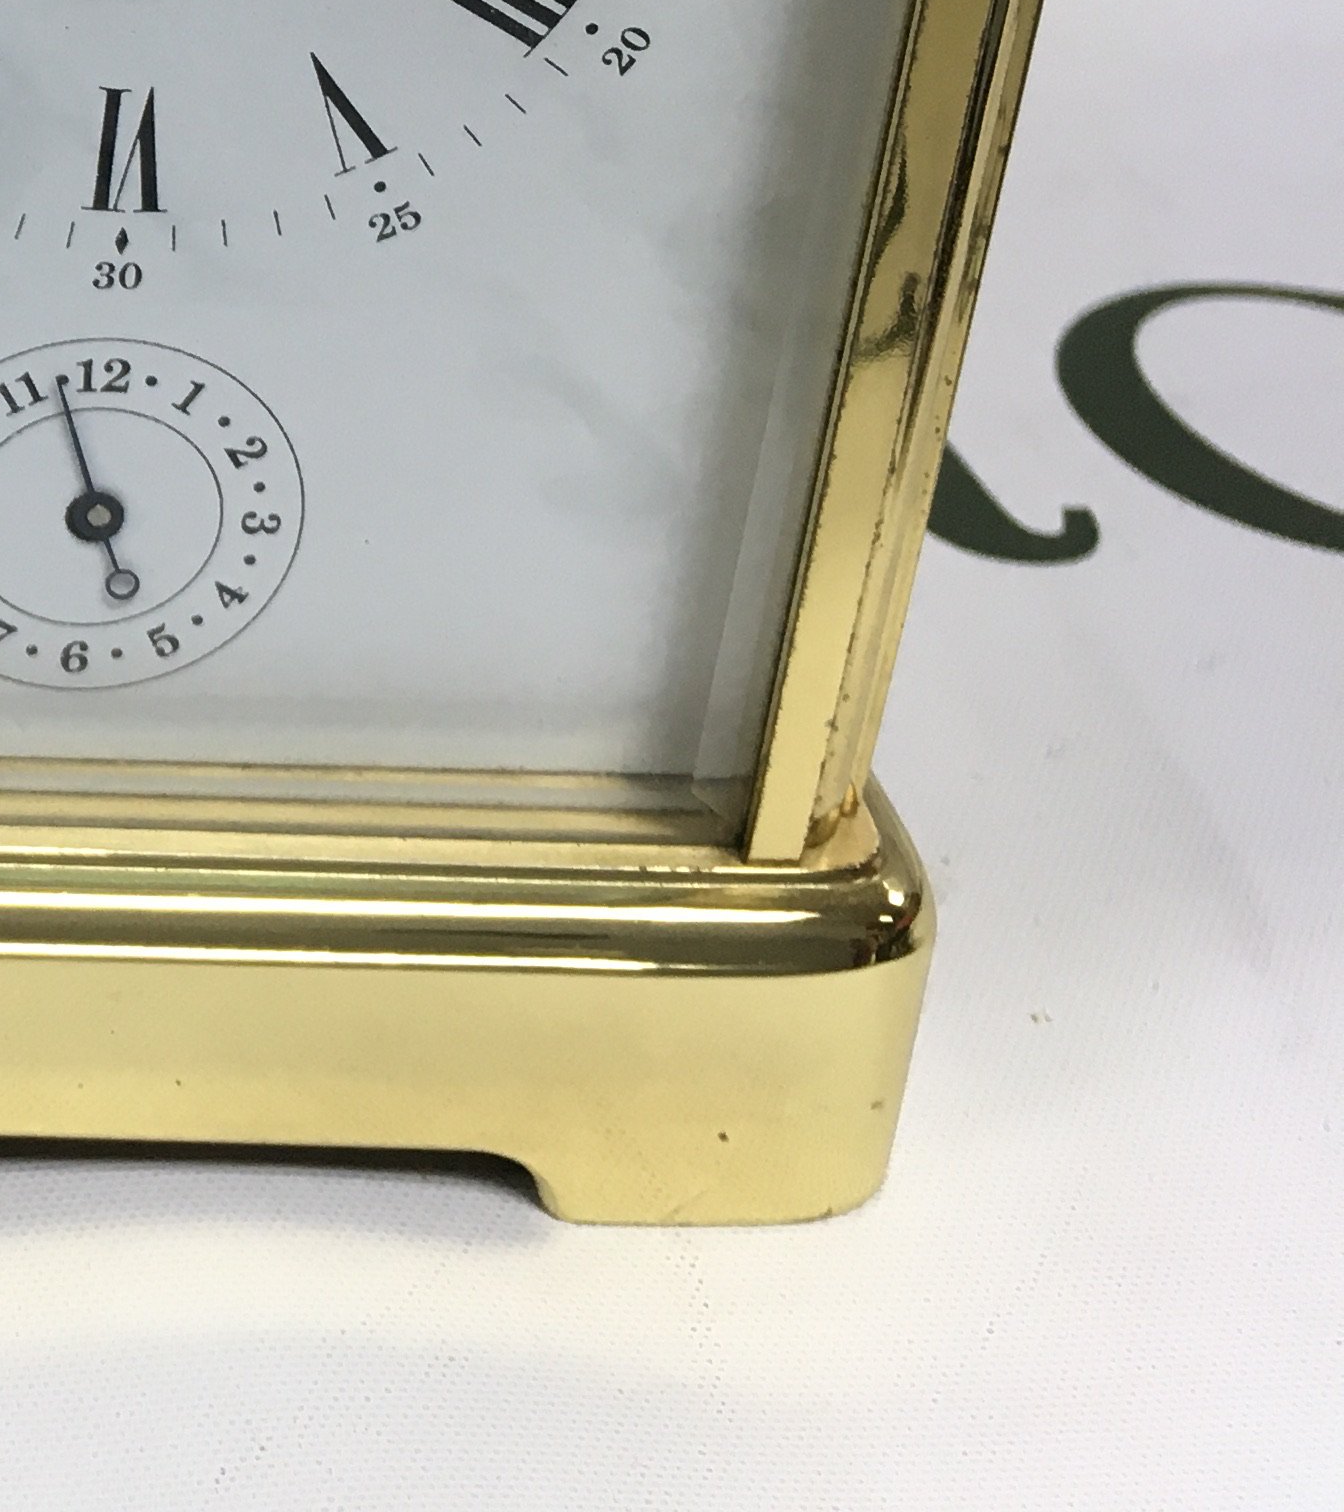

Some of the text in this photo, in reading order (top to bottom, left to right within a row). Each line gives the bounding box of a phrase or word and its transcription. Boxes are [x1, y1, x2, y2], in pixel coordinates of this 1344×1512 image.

[601, 26, 651, 76] 20
[310, 51, 398, 177] V
[81, 86, 168, 213] VI
[368, 201, 422, 242] 25
[92, 261, 142, 289] 30
[76, 358, 132, 393] 12
[171, 380, 206, 416] 1
[224, 436, 268, 469] 2
[240, 511, 282, 536] 3
[214, 580, 249, 609] 4
[59, 640, 89, 673] 6
[146, 622, 181, 658] 5
